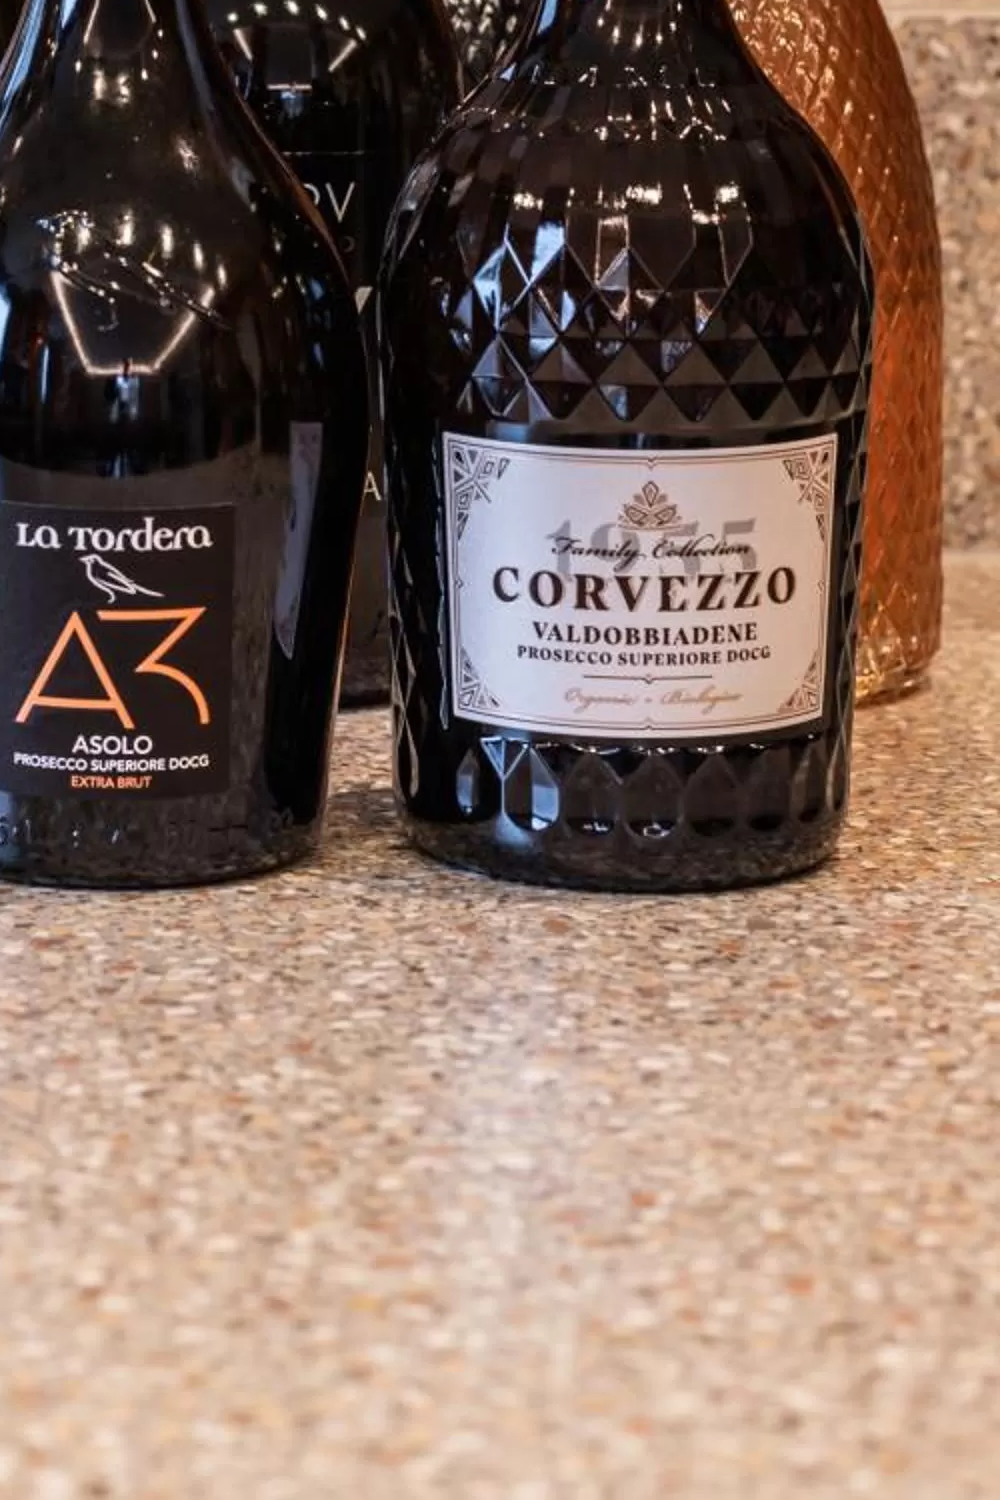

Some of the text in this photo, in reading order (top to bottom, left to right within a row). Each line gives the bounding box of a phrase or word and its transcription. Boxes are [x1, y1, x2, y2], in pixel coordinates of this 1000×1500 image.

[492, 566, 797, 612] CORVEZZO
[532, 621, 758, 646] VALDOBBIADENE
[517, 645, 772, 667] PROSECCO SUPERIORE DOCG
[14, 606, 211, 730] A3
[71, 734, 153, 755] ASOLO
[13, 752, 209, 772] PROSECCO SUPERIORE DOCG
[71, 775, 152, 788] EXTRA BRUT
